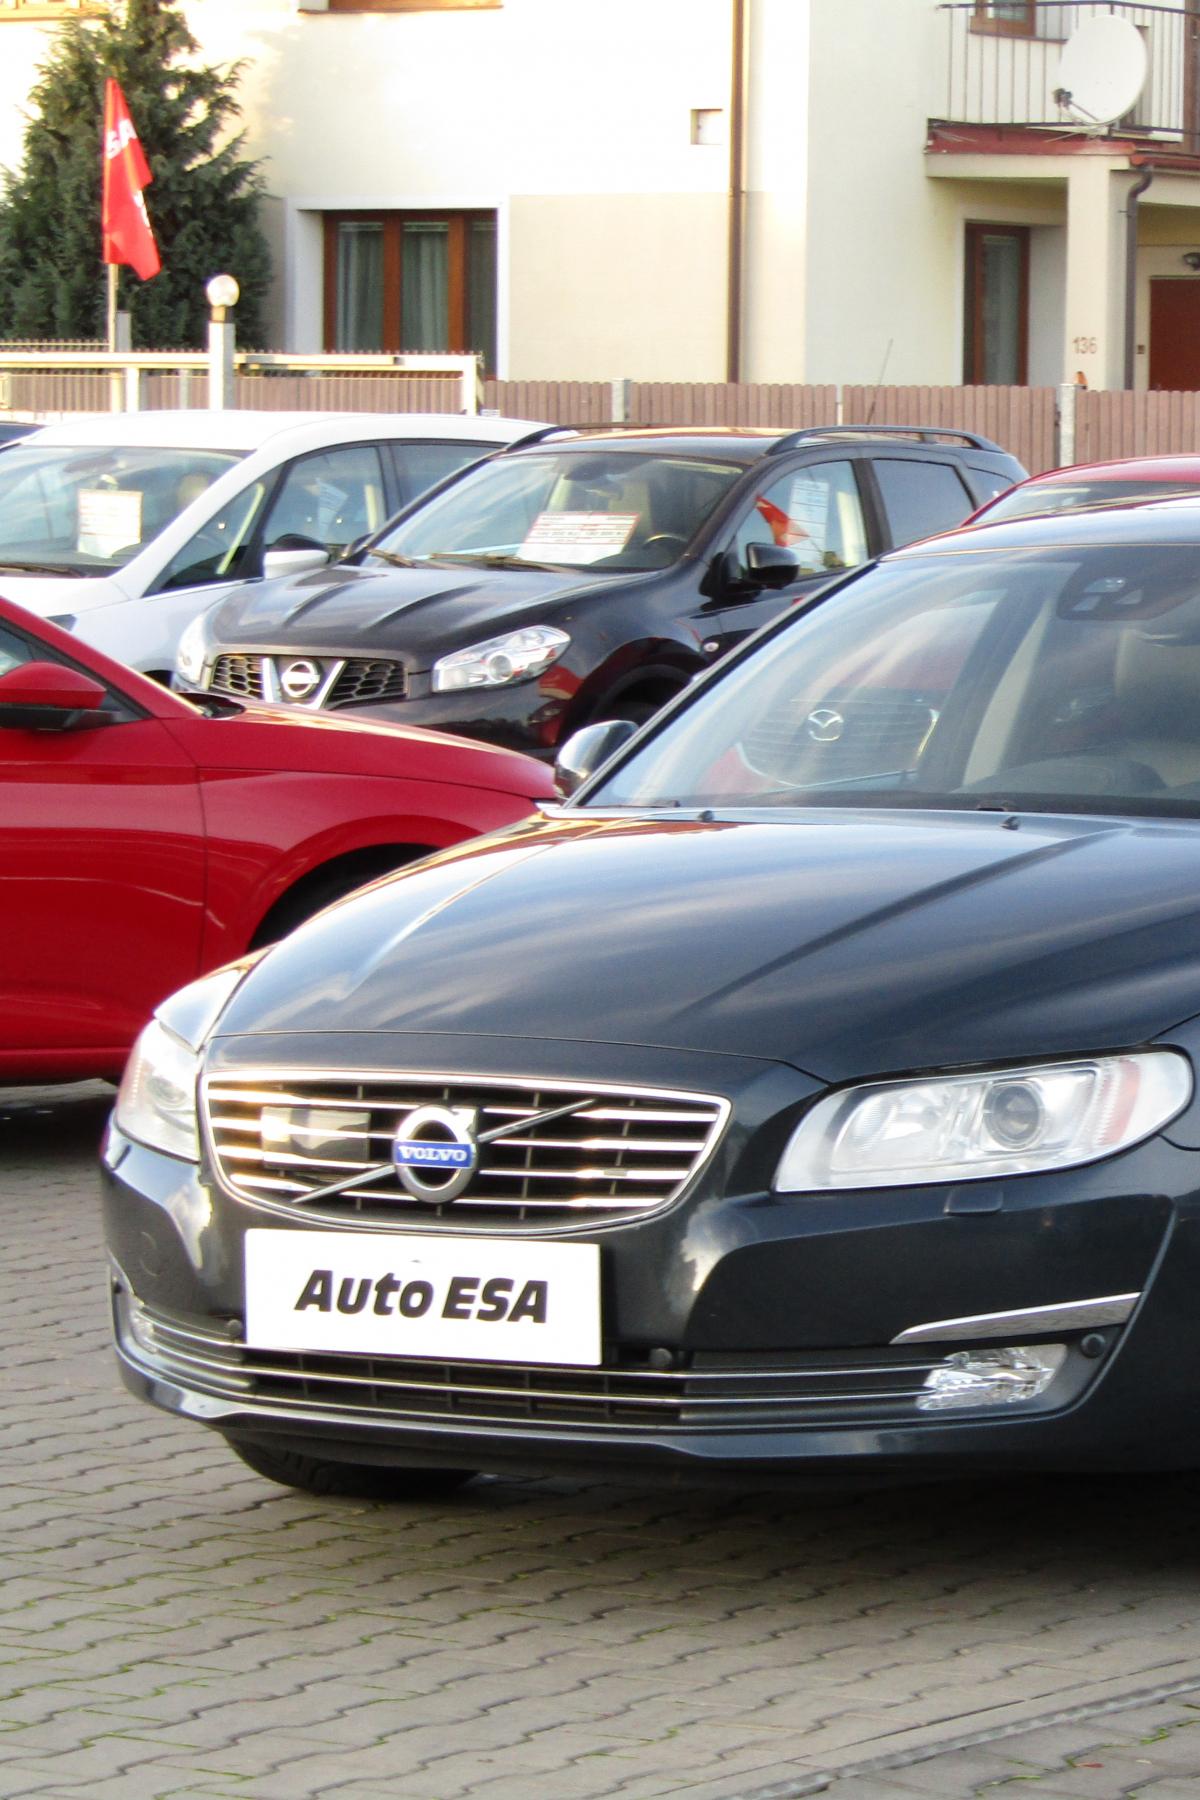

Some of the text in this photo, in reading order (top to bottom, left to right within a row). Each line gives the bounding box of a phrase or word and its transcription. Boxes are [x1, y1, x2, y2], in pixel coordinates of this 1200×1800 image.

[1072, 336, 1098, 354] 136
[398, 1145, 468, 1162] VOLVO
[294, 1269, 548, 1323] Auto ESA
